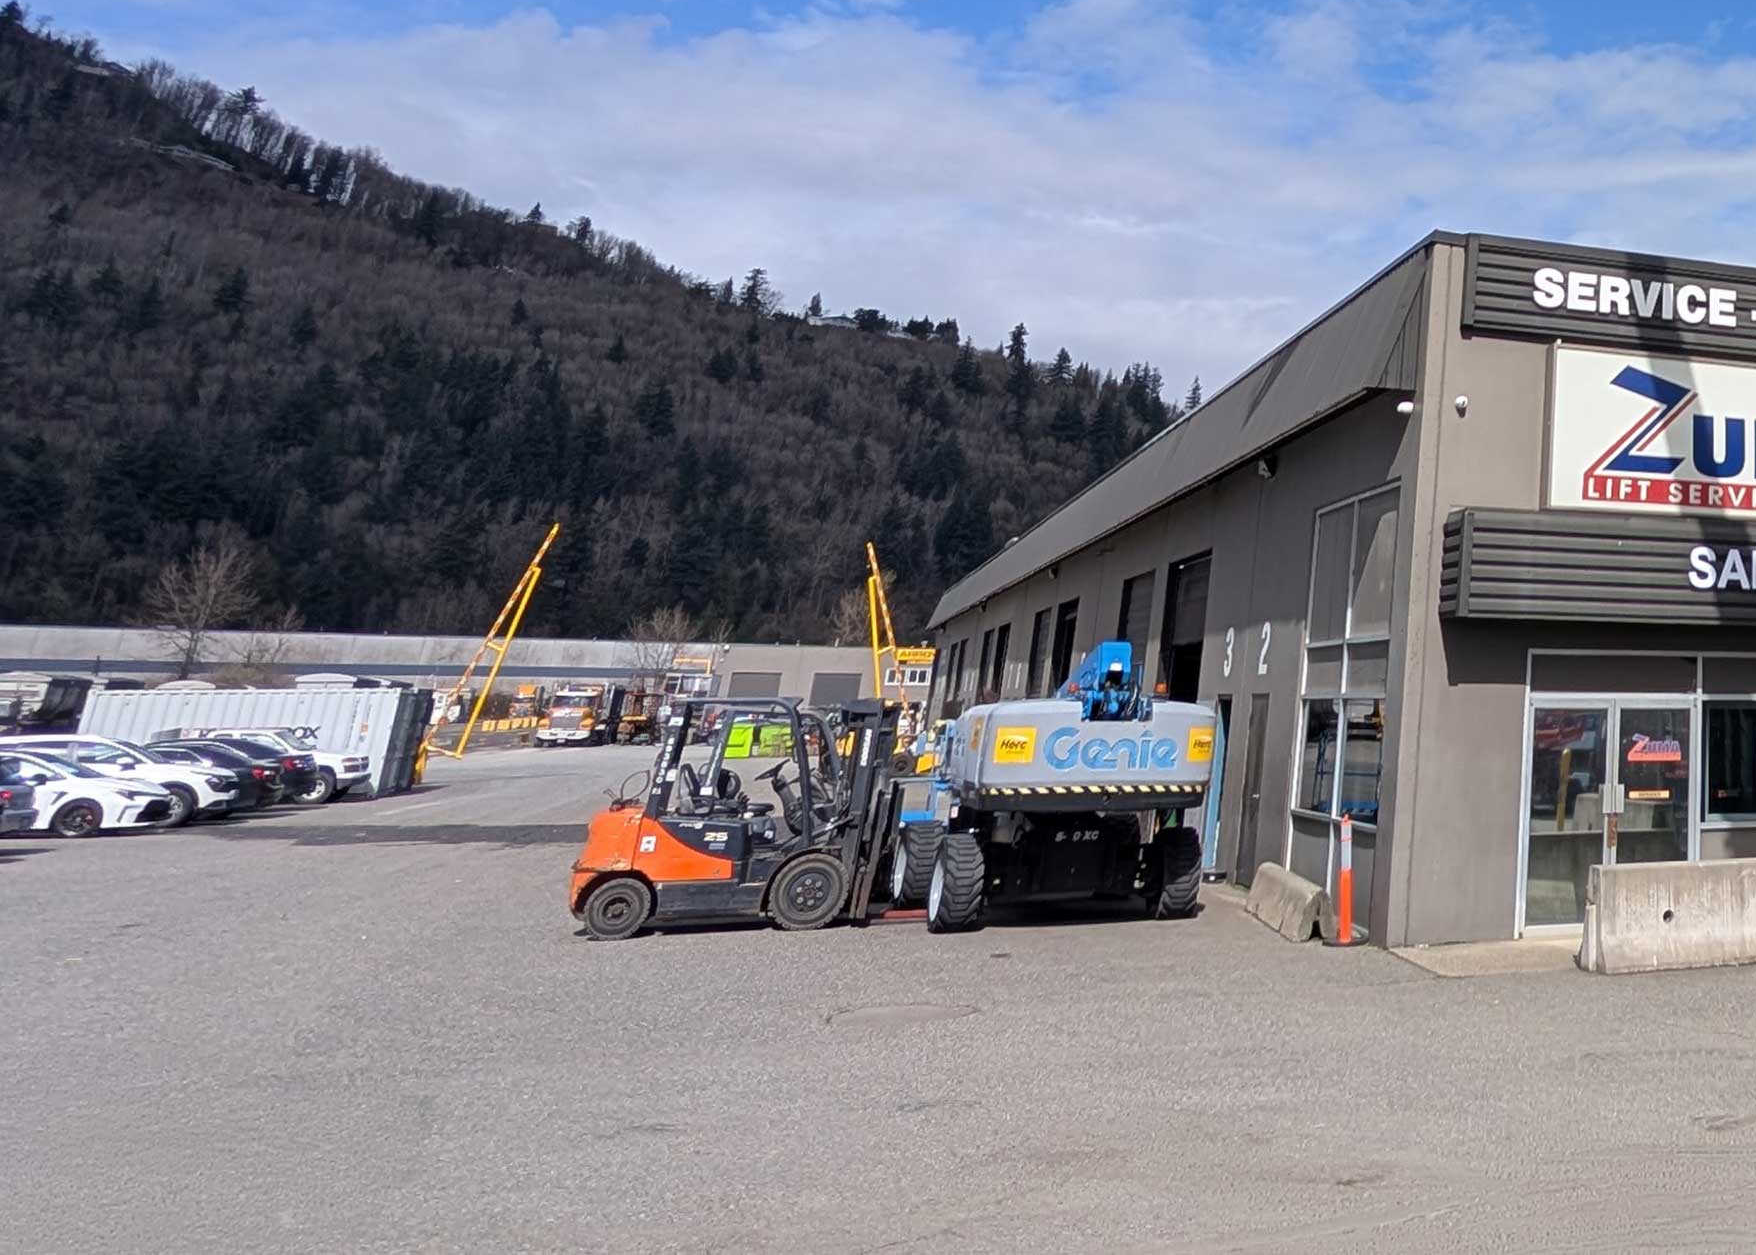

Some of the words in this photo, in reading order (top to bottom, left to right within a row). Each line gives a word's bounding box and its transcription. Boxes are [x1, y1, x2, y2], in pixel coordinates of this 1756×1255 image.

[1533, 268, 1737, 327] SERVICE
[1587, 477, 1652, 502] LIFT
[1223, 627, 1235, 678] 3
[1258, 621, 1272, 675] 2
[1043, 727, 1178, 771] Genie
